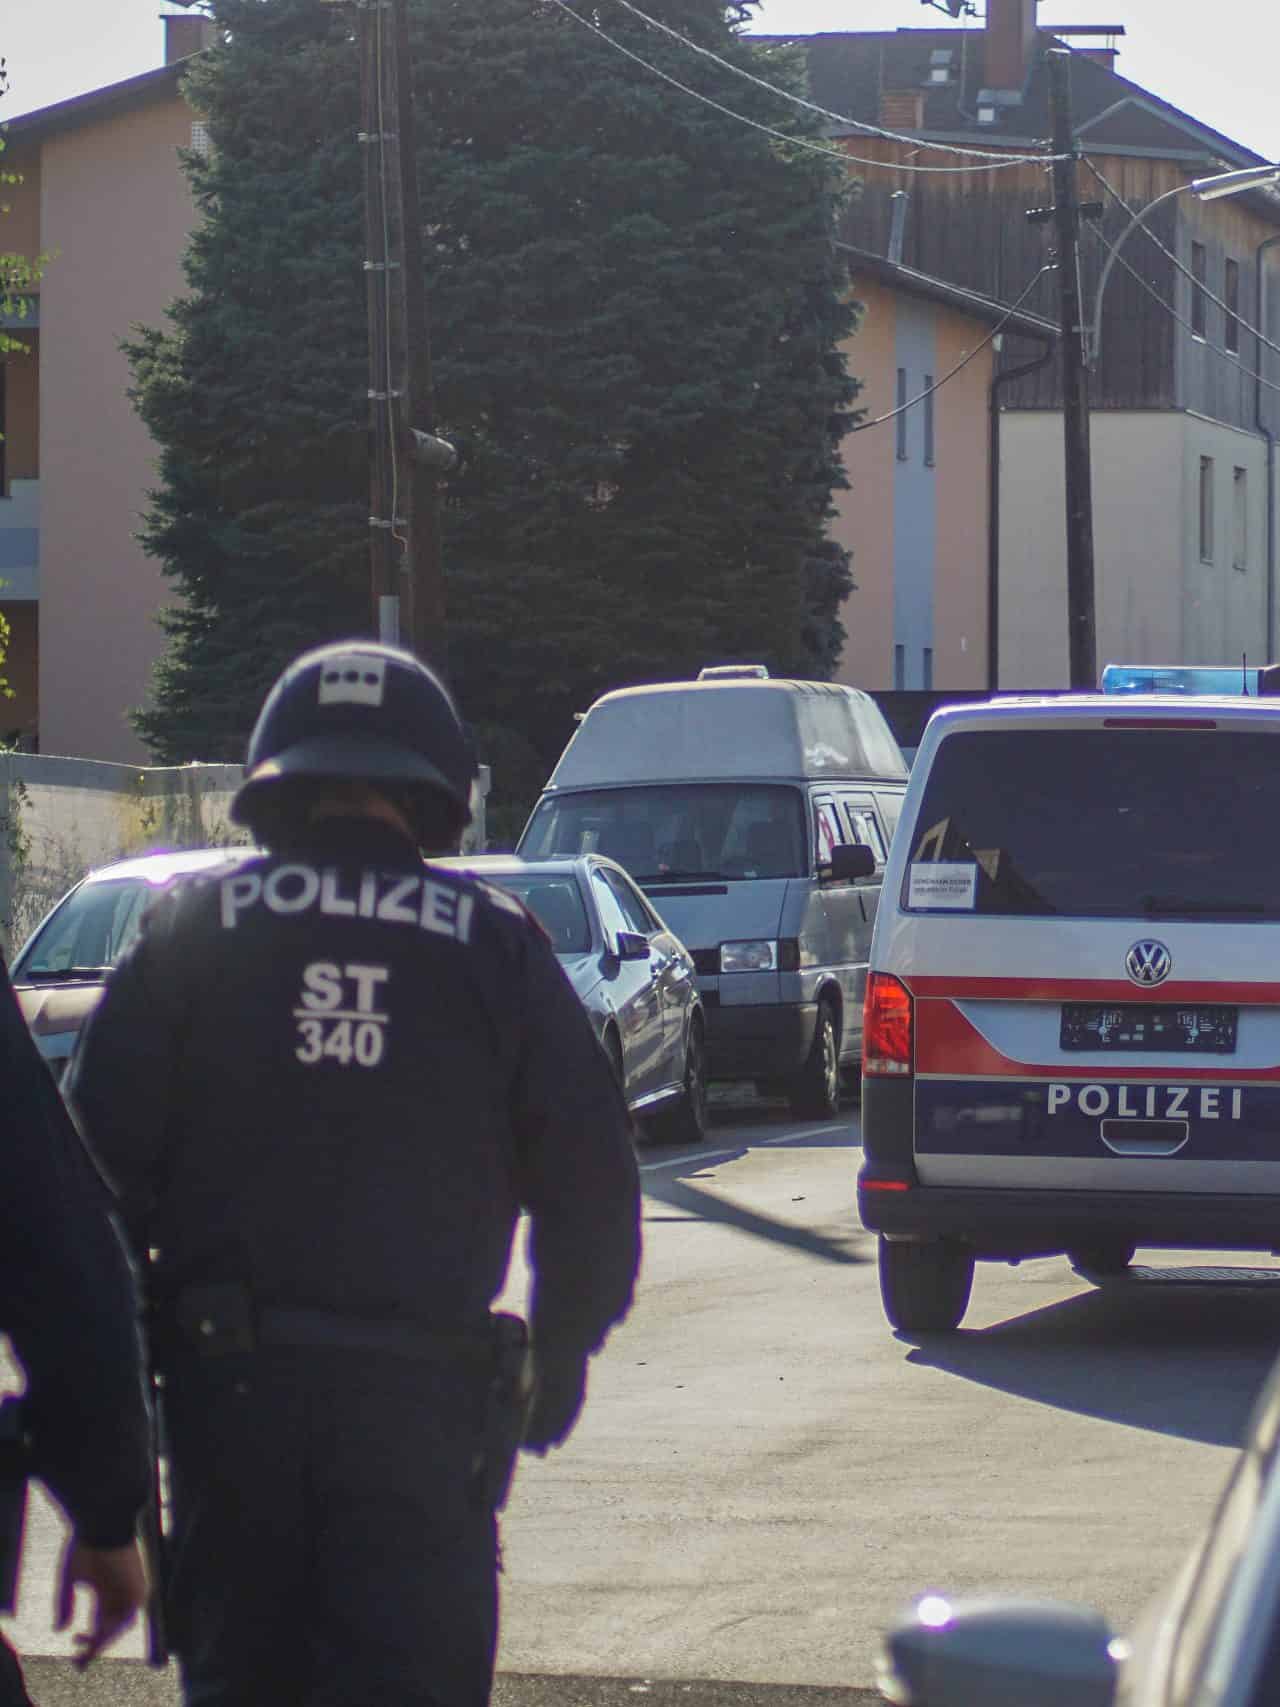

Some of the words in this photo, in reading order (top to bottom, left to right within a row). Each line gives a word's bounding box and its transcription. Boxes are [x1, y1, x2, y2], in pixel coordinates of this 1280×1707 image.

[219, 864, 475, 944] POLIZEI
[301, 961, 389, 1013] ST
[295, 1020, 384, 1067] 340
[1047, 1084, 1242, 1120] POLIZEI
